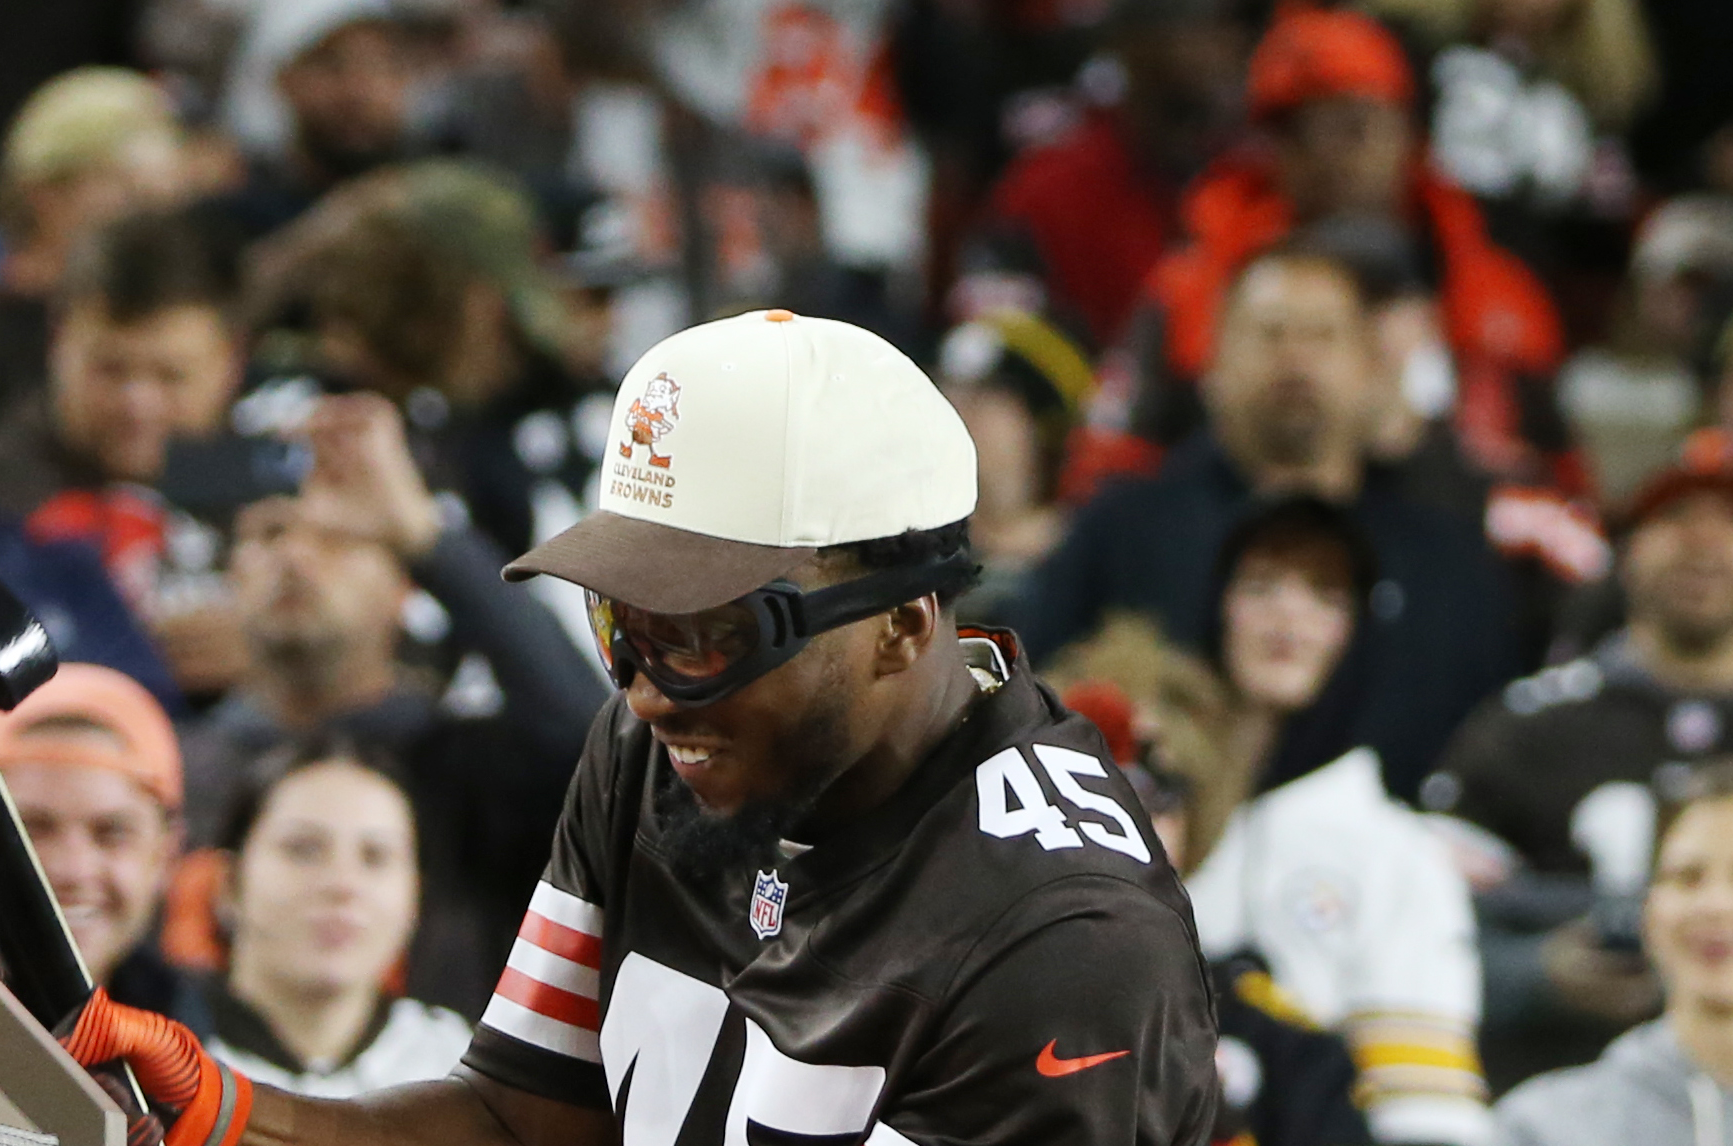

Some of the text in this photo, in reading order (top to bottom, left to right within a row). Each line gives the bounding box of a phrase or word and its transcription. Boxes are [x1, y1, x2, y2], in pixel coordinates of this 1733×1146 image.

[612, 462, 676, 488] CLEVELAND
[610, 479, 674, 508] BROWNS
[976, 743, 1152, 864] 45
[753, 900, 776, 927] NFL
